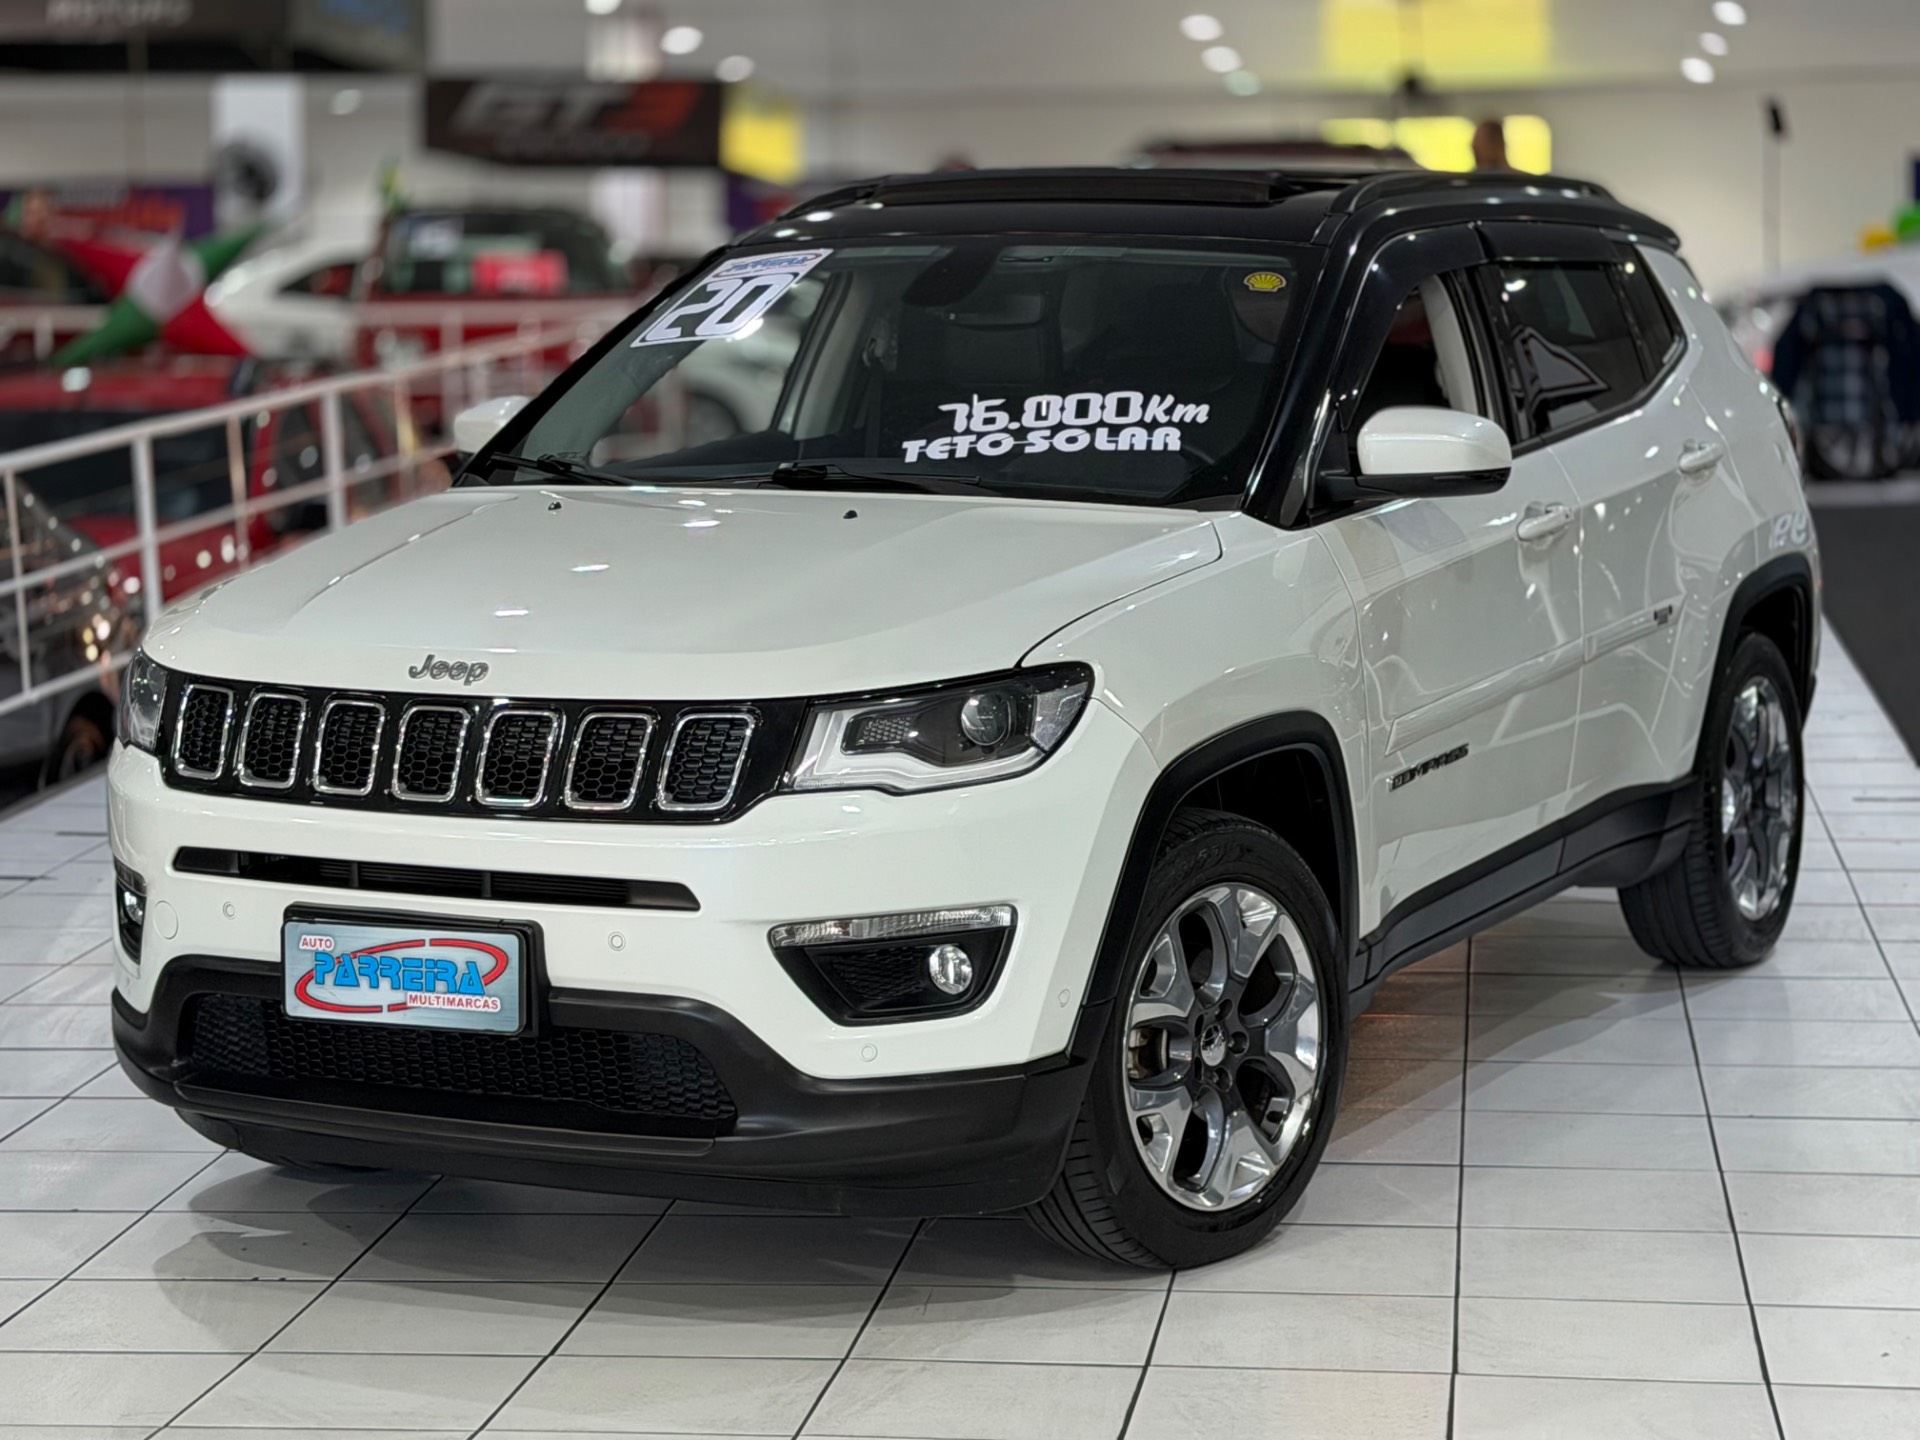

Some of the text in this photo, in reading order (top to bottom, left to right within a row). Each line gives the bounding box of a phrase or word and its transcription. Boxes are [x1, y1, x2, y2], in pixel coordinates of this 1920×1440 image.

[645, 272, 795, 341] 20
[902, 427, 1182, 463] TETO SOLAR
[408, 654, 489, 686] Jeep
[301, 938, 333, 950] AUTO
[314, 952, 486, 995] PARREIRA
[408, 994, 500, 1010] MULTIMARCAS
